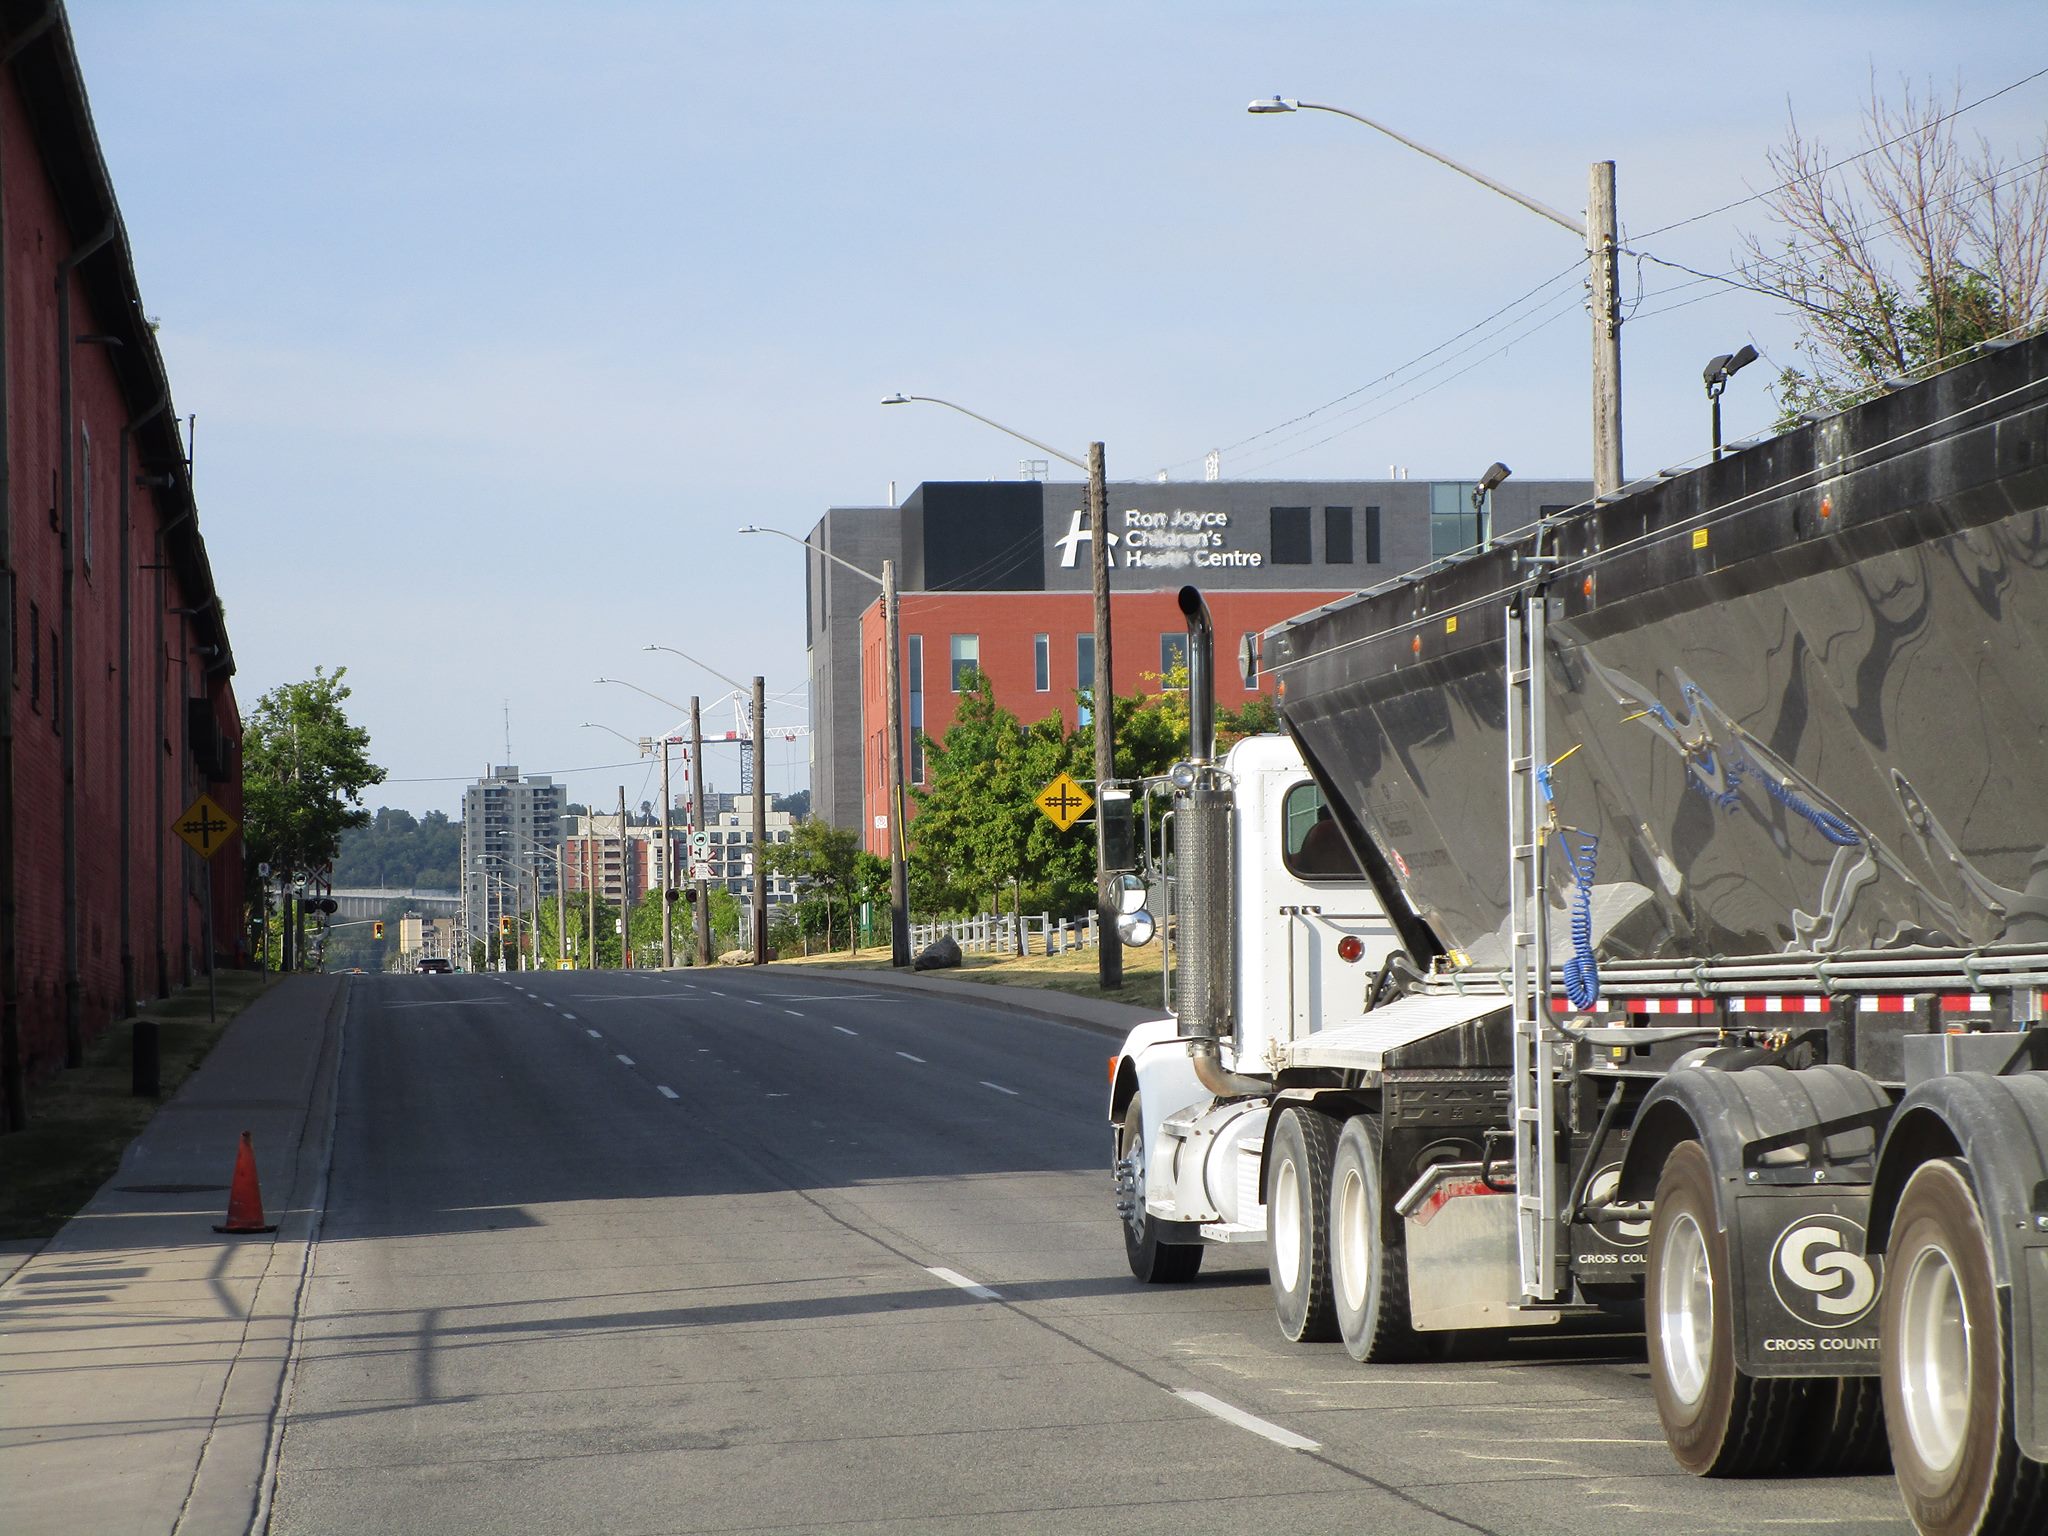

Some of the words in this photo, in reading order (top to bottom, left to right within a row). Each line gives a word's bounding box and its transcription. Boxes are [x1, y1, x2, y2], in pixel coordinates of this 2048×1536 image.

[1125, 509, 1167, 527] Ron
[1170, 508, 1228, 530] Joyce
[1193, 550, 1261, 567] Centre
[1579, 1254, 1618, 1264] CROSS
[1764, 1339, 1816, 1351] CROSS
[1820, 1338, 1880, 1350] COUNT
